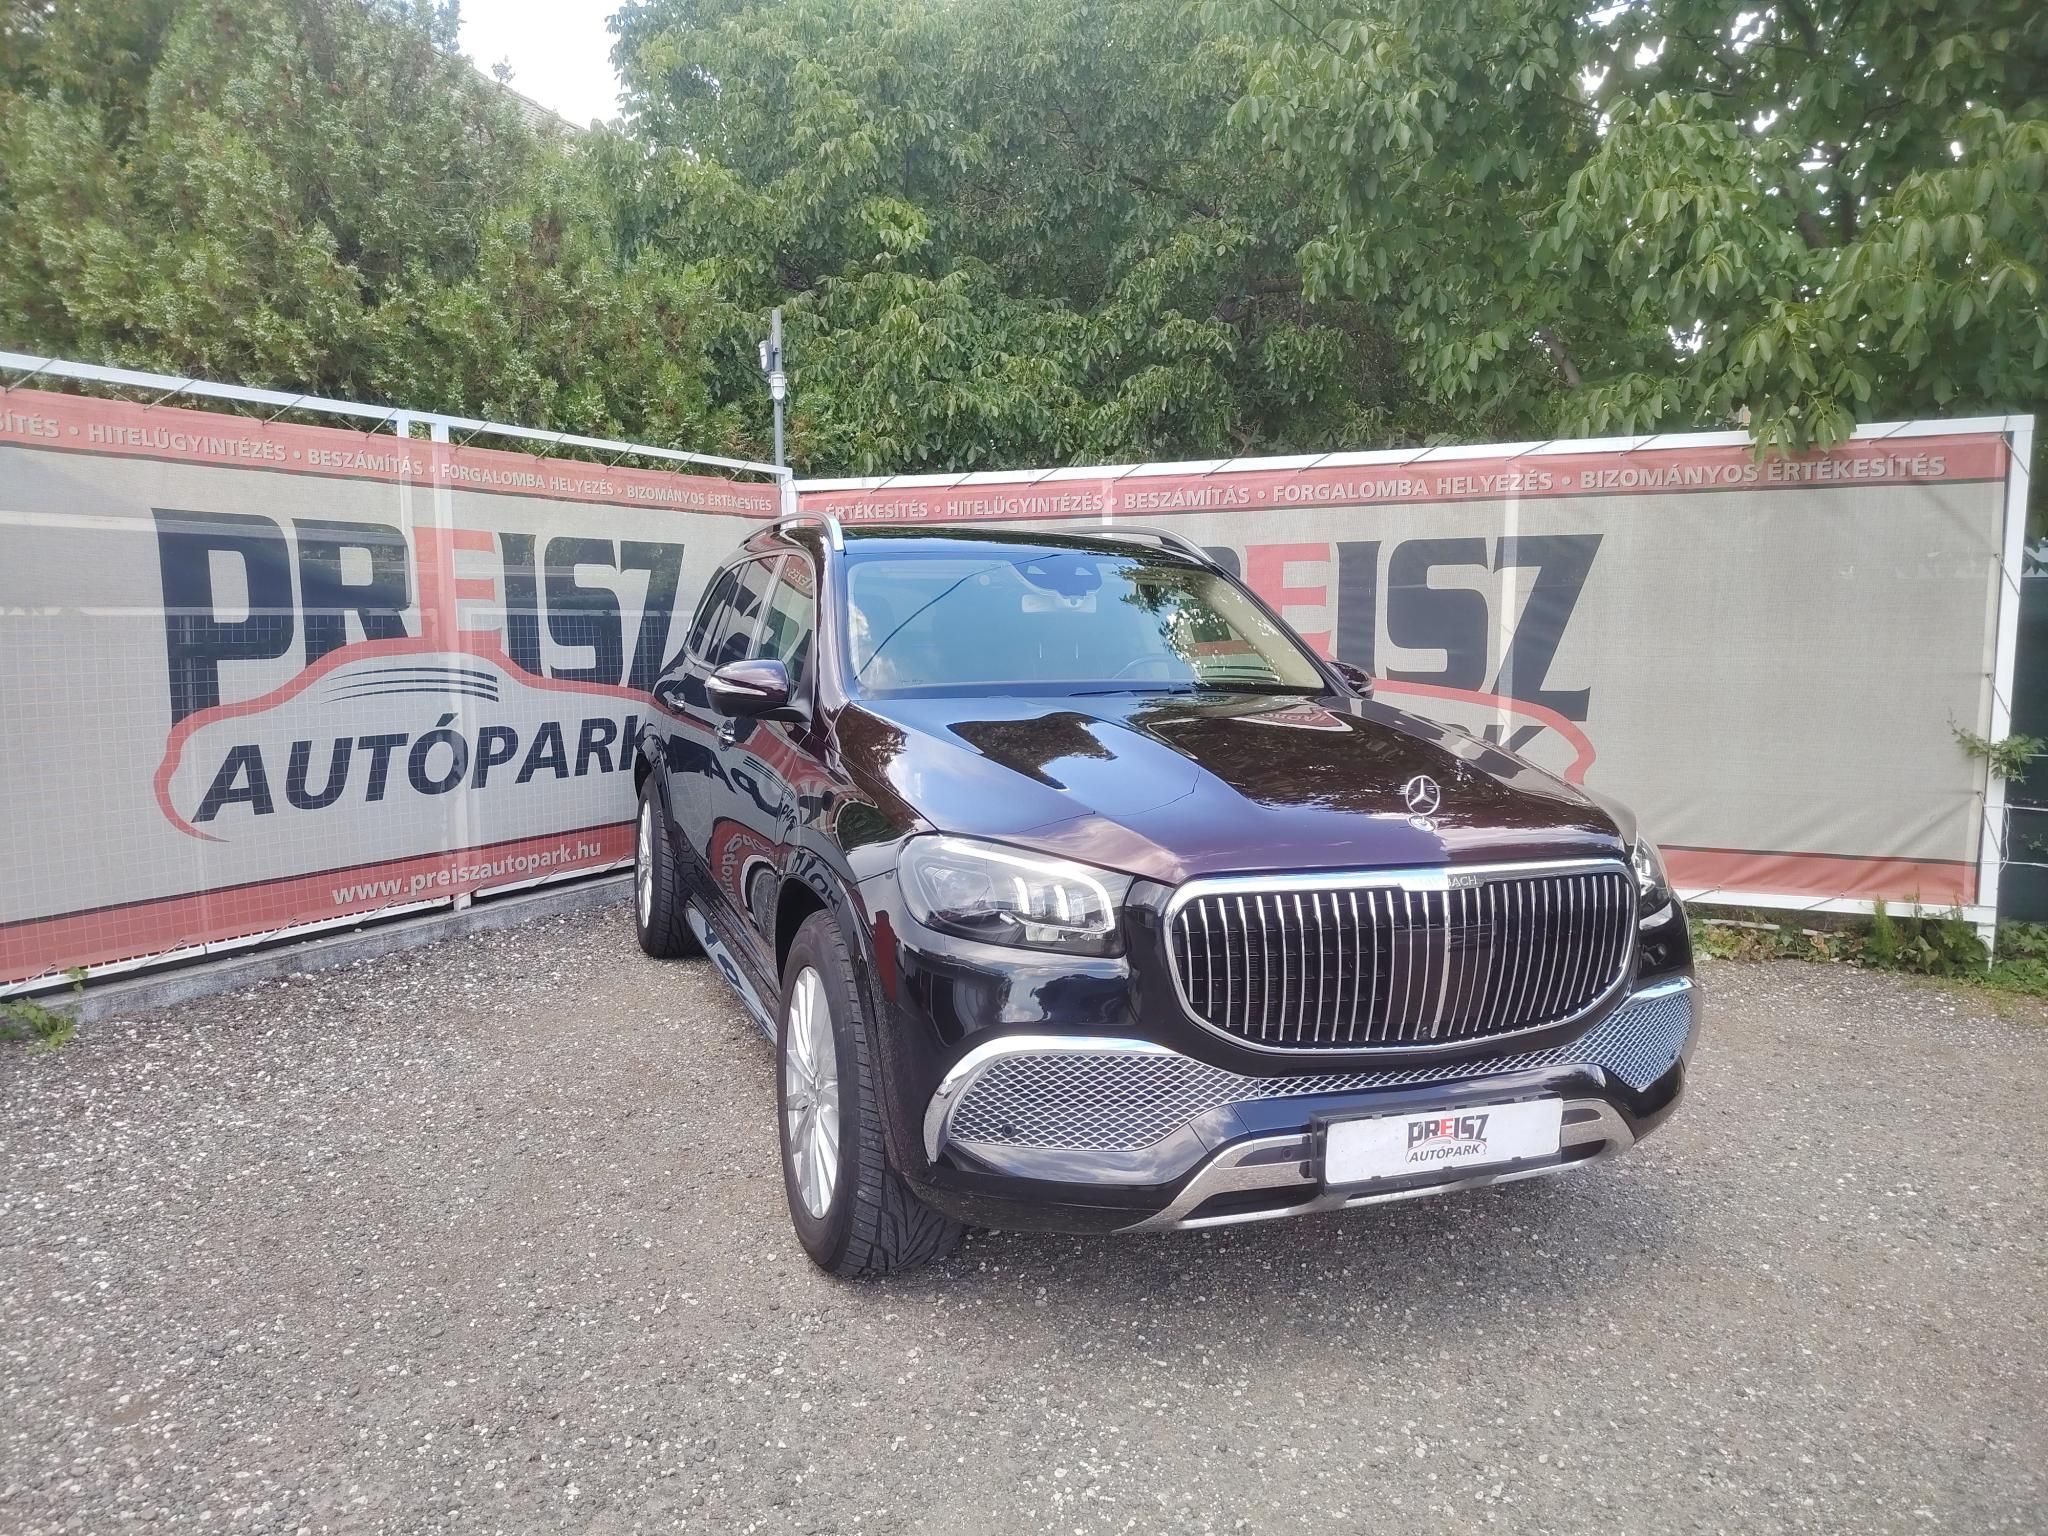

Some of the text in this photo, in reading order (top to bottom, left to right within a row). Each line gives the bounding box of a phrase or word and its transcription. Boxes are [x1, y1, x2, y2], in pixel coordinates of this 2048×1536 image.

[0, 408, 773, 512] ÍTÉS HITELÜGYINTÉZÉS BESZÁMÍTÁS FORGALOMBA HELYEZÉS BIZOMÁNYOS ÉRTÉKESÍTÉS
[946, 492, 1104, 517] HITELÜGYINTÉZÉS
[1124, 484, 1250, 509] BESZÁMÍTÁS
[1273, 479, 1430, 503] FORGALOMBA
[1436, 469, 1552, 495] HELYEZÉS
[1580, 463, 1760, 490] BIZOMÁNYOS
[1766, 453, 1947, 482] ÉRTÉKESÍTÉS
[151, 508, 685, 727] PREISZ
[1203, 533, 1604, 722] EISZ
[331, 840, 601, 906] www.preiszautopark.hu
[1407, 1113, 1489, 1149] PREISZ
[1408, 1143, 1482, 1163] AUTÓPARK
